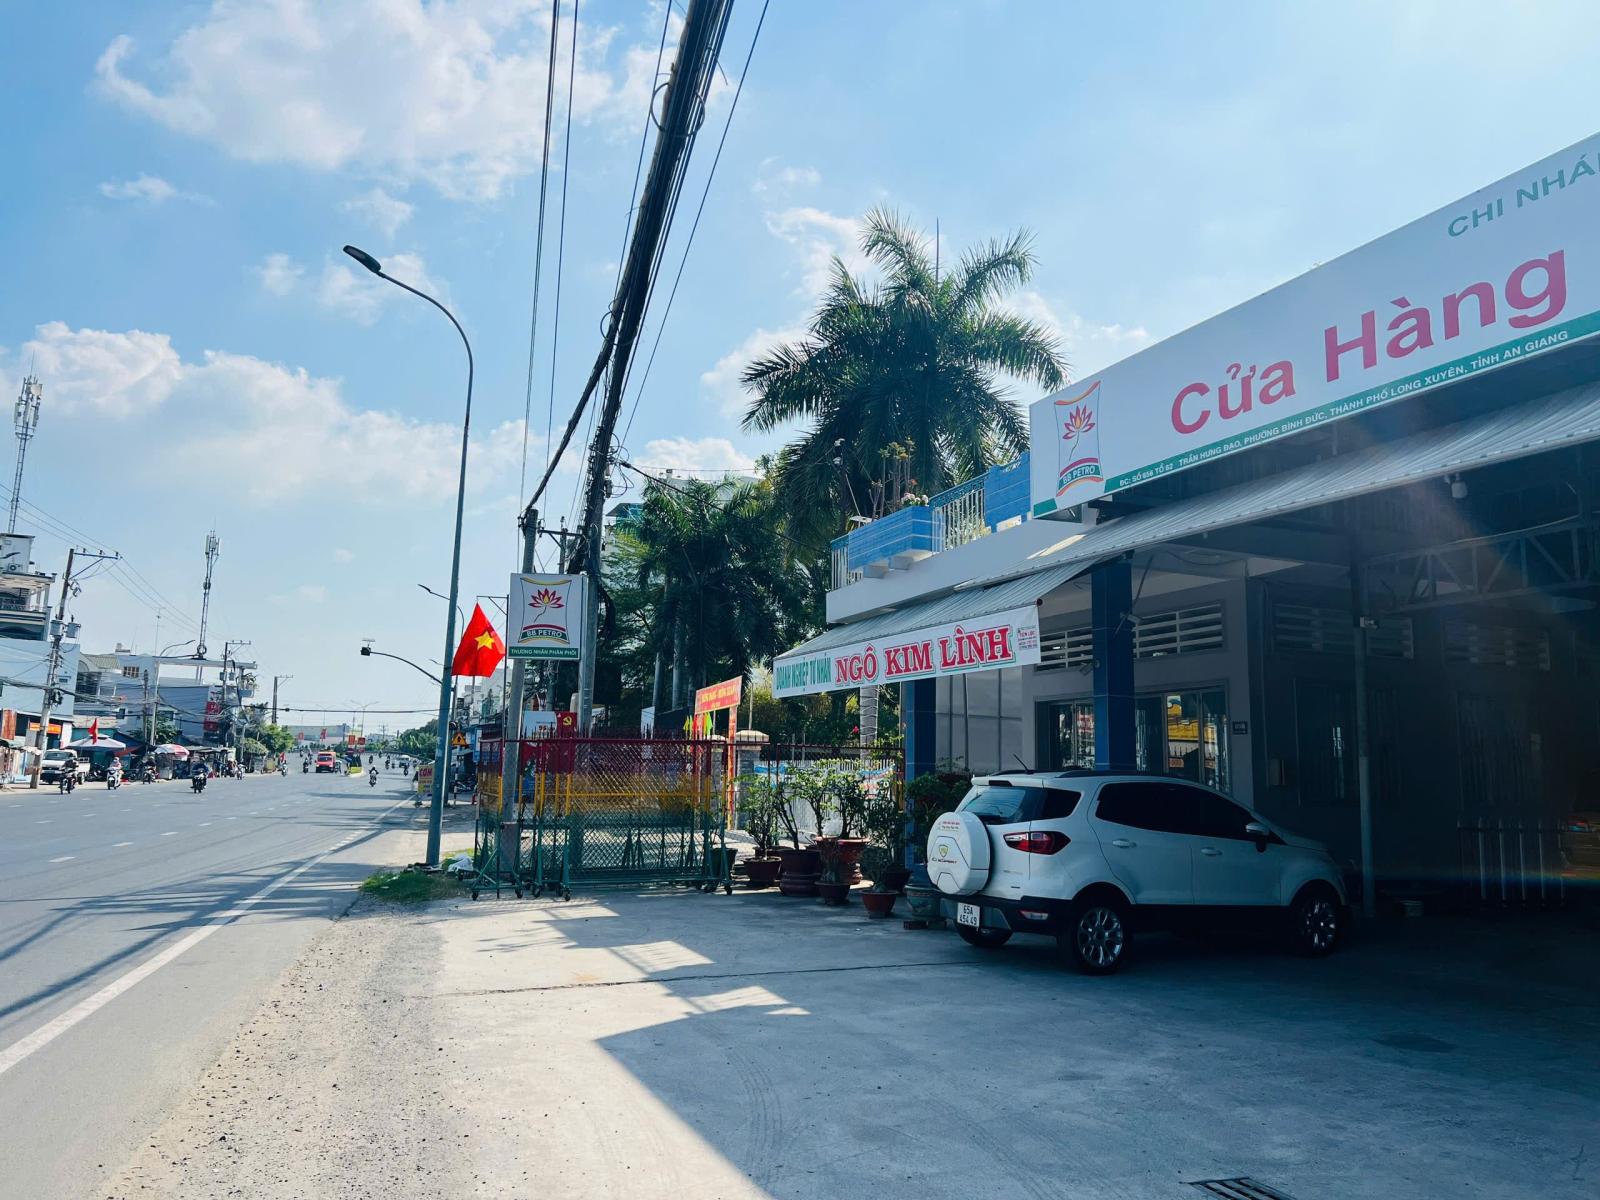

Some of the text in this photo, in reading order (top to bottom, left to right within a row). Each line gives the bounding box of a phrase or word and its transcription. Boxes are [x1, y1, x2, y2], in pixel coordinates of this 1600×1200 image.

[1447, 153, 1600, 238] CHI NHÁ
[1171, 249, 1568, 435] Cửa Hàng
[1200, 445, 1222, 460] HƯNG
[1281, 419, 1303, 433] BÌNH
[1305, 411, 1327, 425] ĐỨC,
[1330, 399, 1364, 417] THÀNH
[1366, 387, 1389, 405] PHỐ
[1391, 379, 1422, 397] LONG
[1424, 364, 1468, 386] XUYÊN,
[1503, 346, 1521, 360] AN
[1524, 330, 1568, 352] GIANG
[1072, 465, 1096, 479] PETRO
[538, 629, 563, 637] PETRO
[834, 644, 878, 684] NGÔ
[884, 640, 933, 677] KIM
[963, 905, 974, 915] 65A
